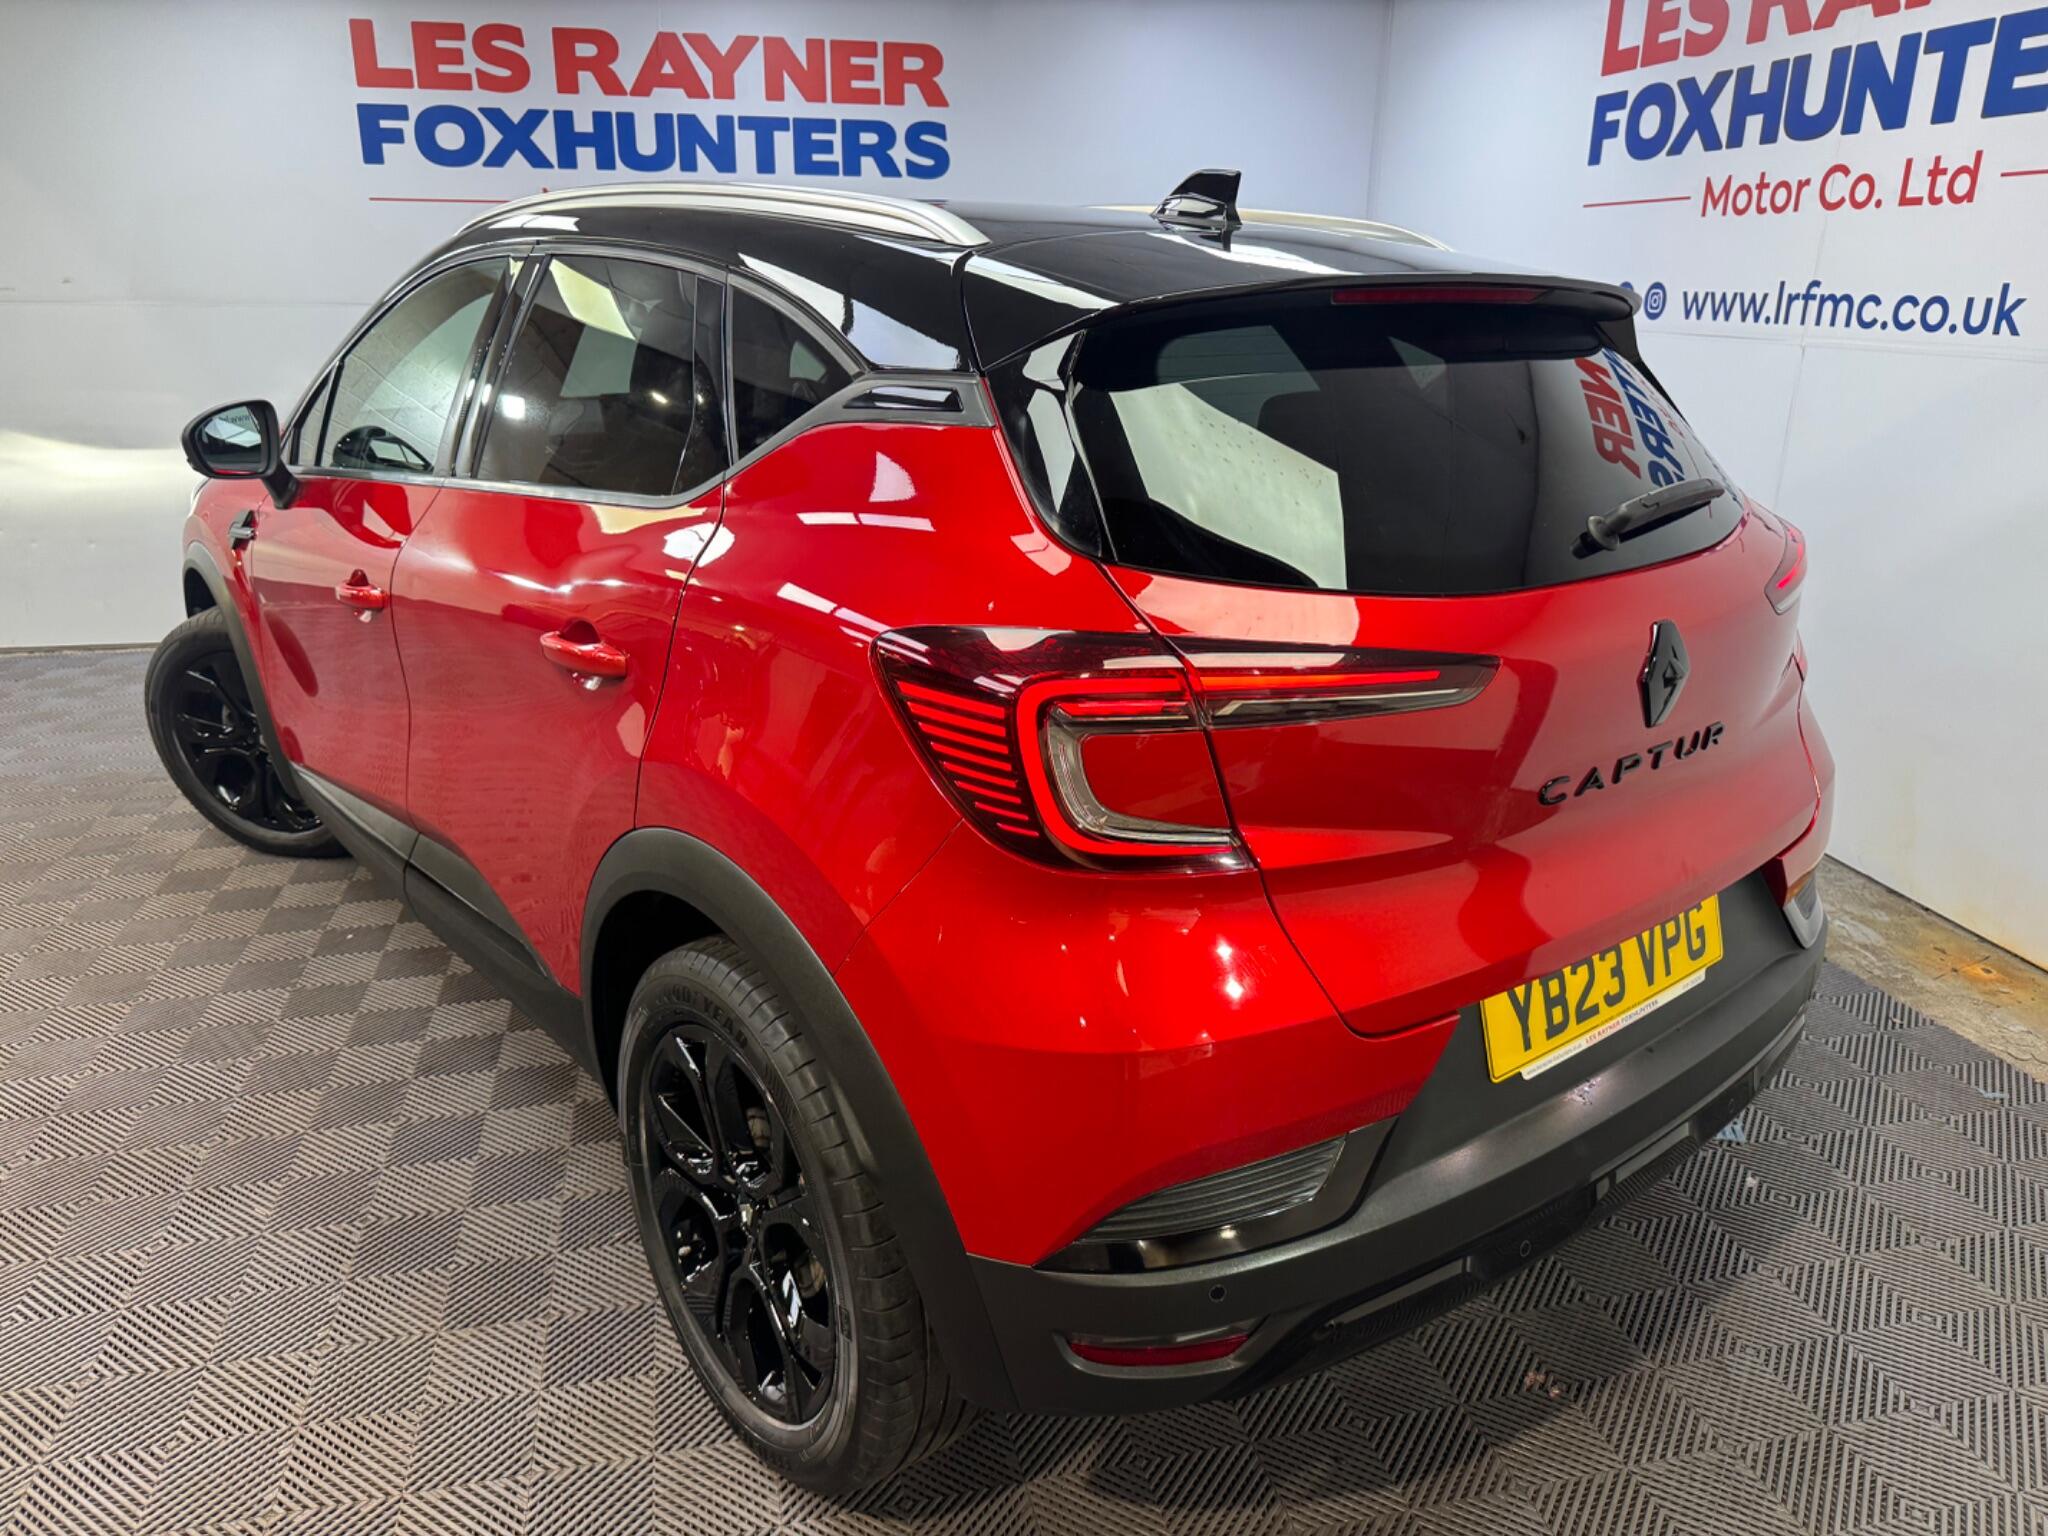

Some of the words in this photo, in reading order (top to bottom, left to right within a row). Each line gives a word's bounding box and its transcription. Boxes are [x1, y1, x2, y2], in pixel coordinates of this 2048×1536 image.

[349, 18, 531, 94] LES
[551, 26, 949, 108] RAYNER
[356, 103, 951, 180] FOXHUNTERS
[1701, 171, 1811, 218] Motor
[1818, 163, 1883, 212] Co.
[1898, 150, 1984, 207] Ltd
[1682, 280, 2027, 337] www.lrfmc.co.uk
[1538, 721, 1725, 807] CAPTUR
[1506, 942, 1627, 1053] YB23
[1635, 903, 1707, 988] VPG
